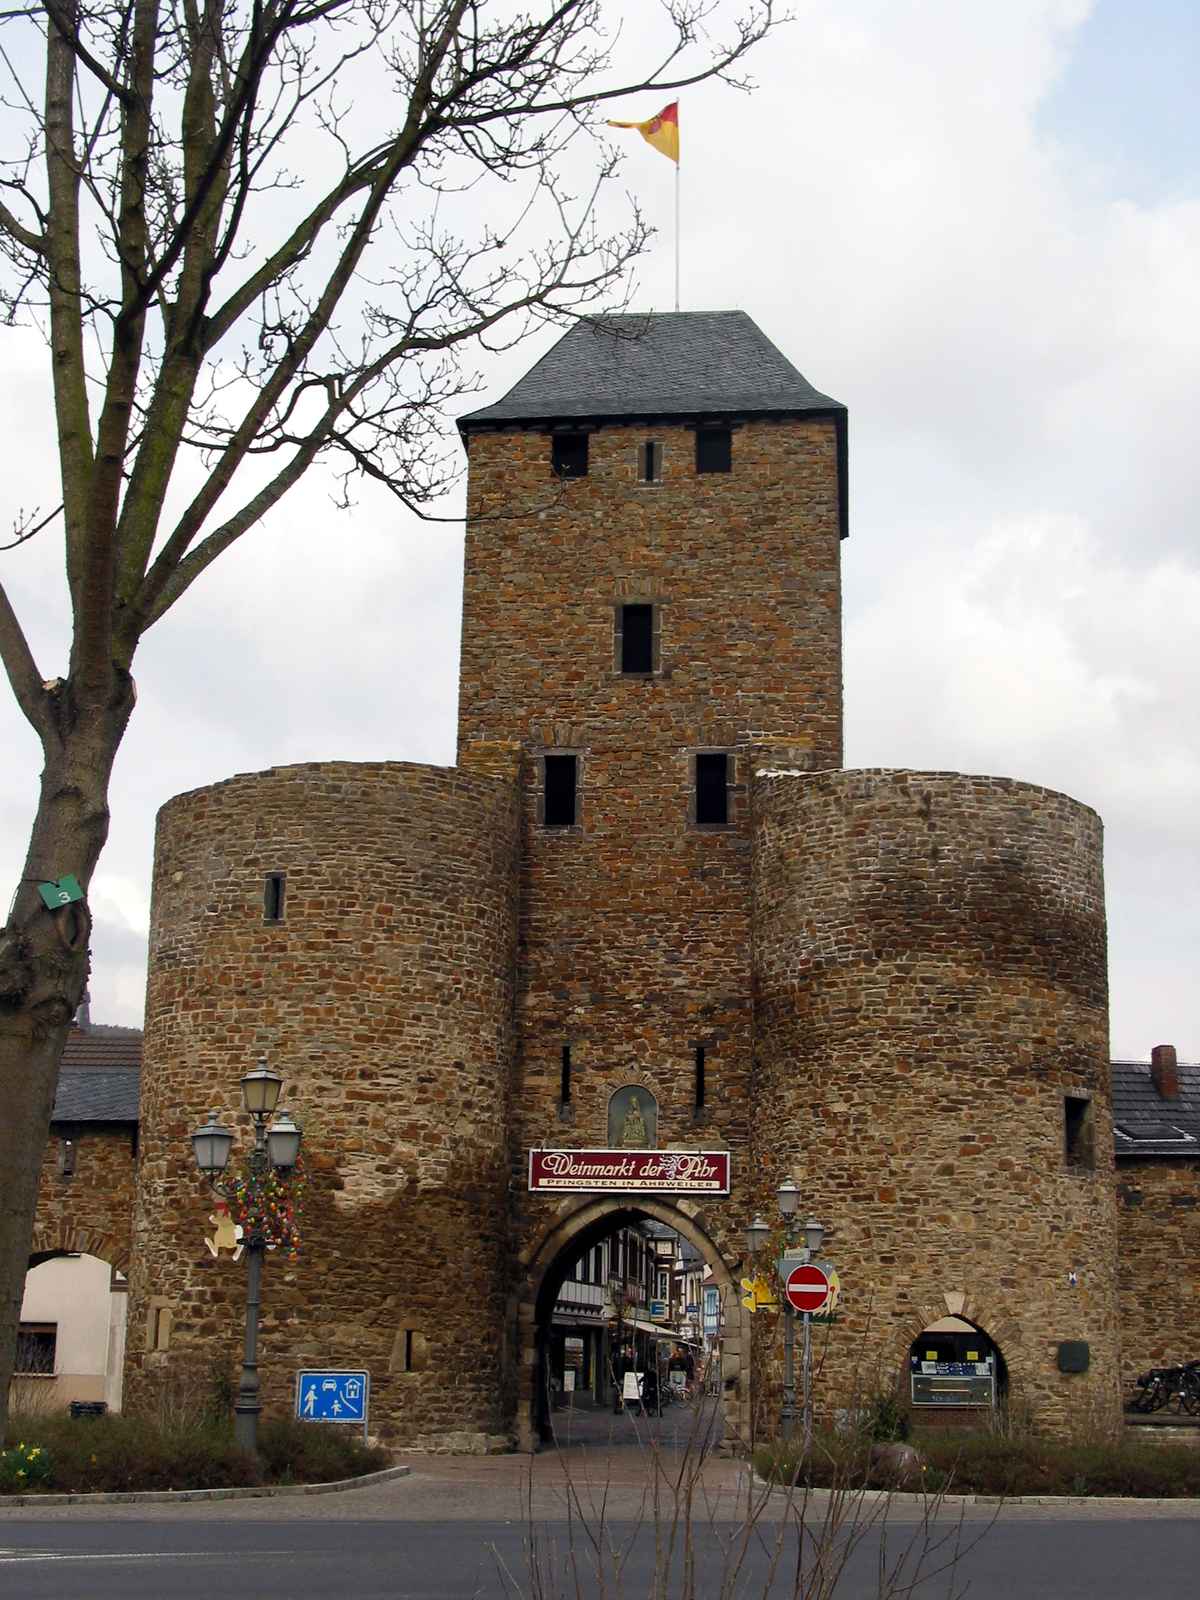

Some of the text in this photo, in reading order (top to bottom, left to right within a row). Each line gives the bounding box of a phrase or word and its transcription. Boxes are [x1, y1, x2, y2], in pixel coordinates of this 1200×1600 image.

[58, 891, 71, 903] 3
[541, 1152, 718, 1180] Weinmarkt der Ahr
[639, 1180, 713, 1188] AHRWEILER
